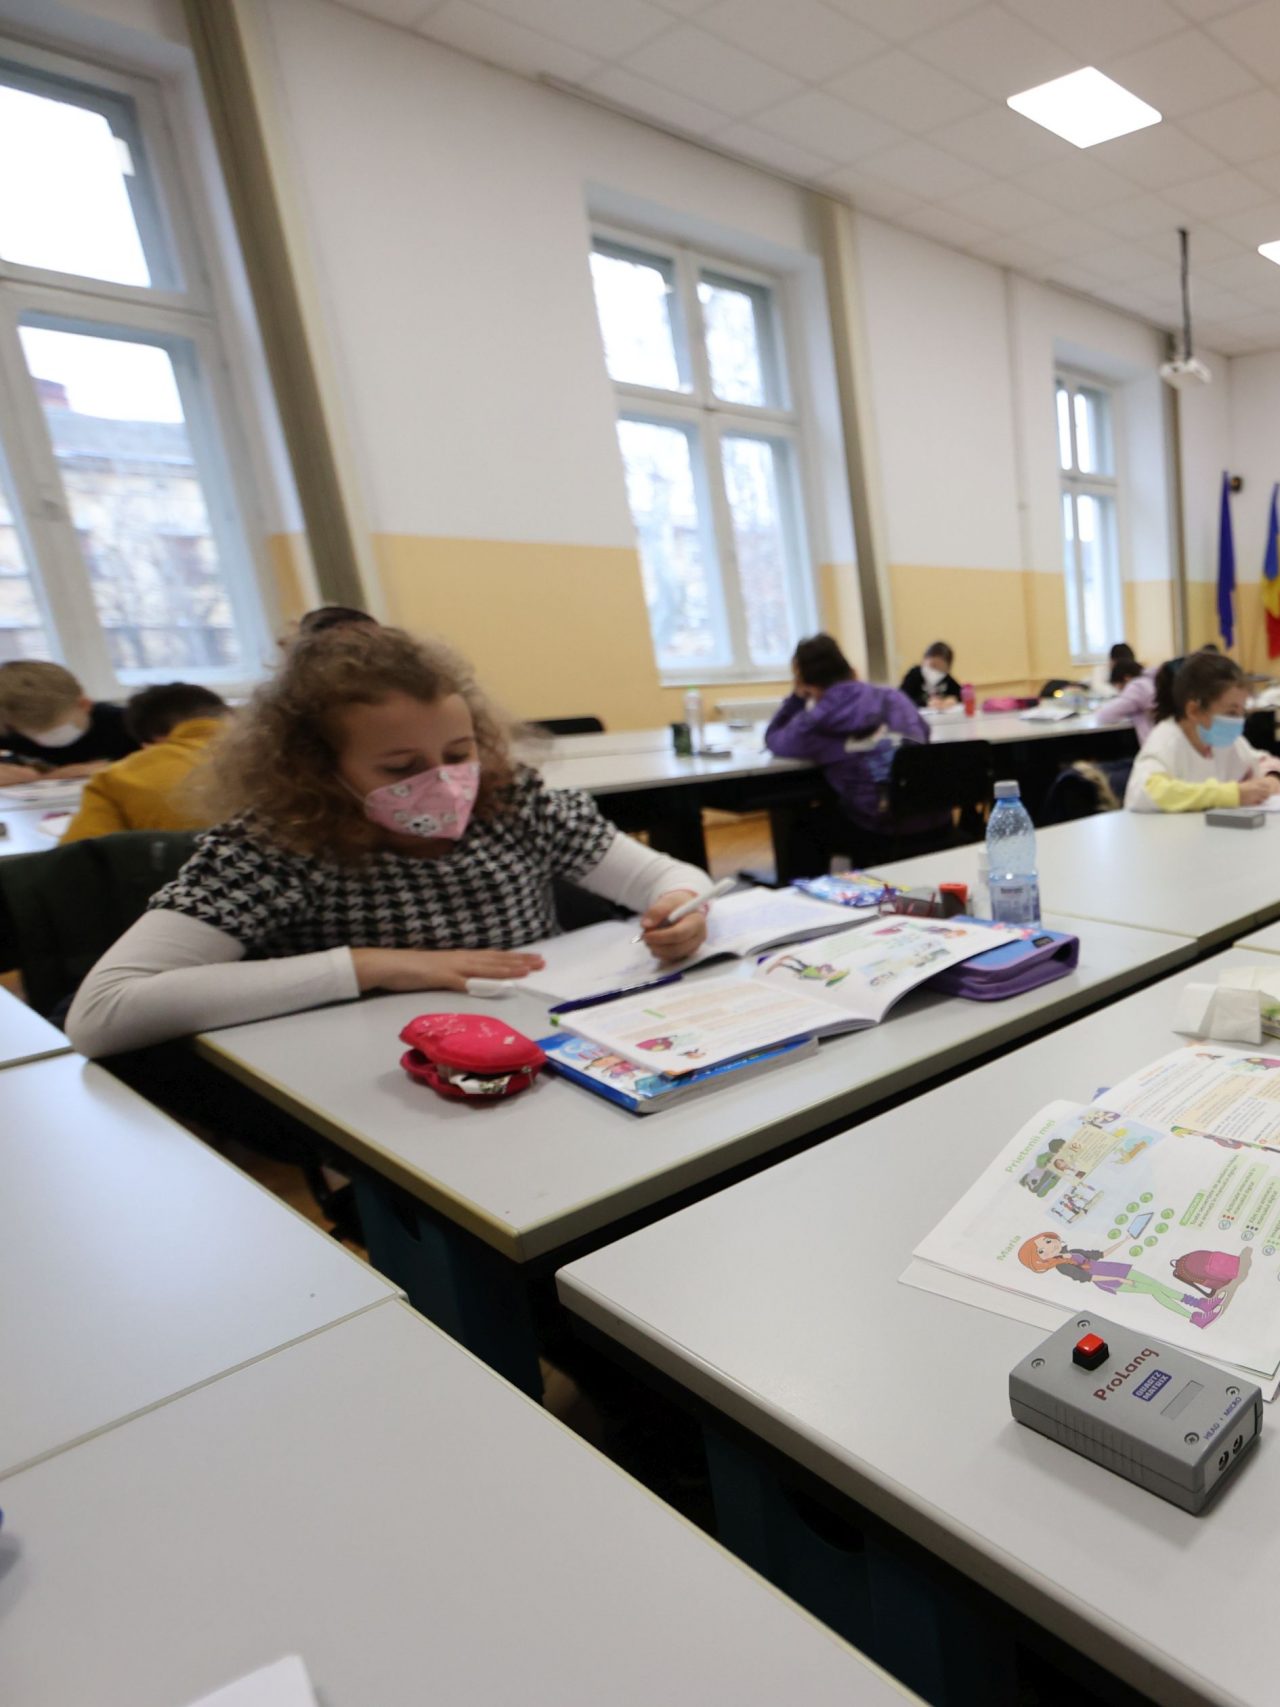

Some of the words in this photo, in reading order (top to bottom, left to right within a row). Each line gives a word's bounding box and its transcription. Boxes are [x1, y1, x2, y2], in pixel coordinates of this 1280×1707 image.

[1093, 1347, 1160, 1401] ProLang
[1135, 1370, 1163, 1397] QUARTZ
[1142, 1374, 1170, 1400] MATRIX
